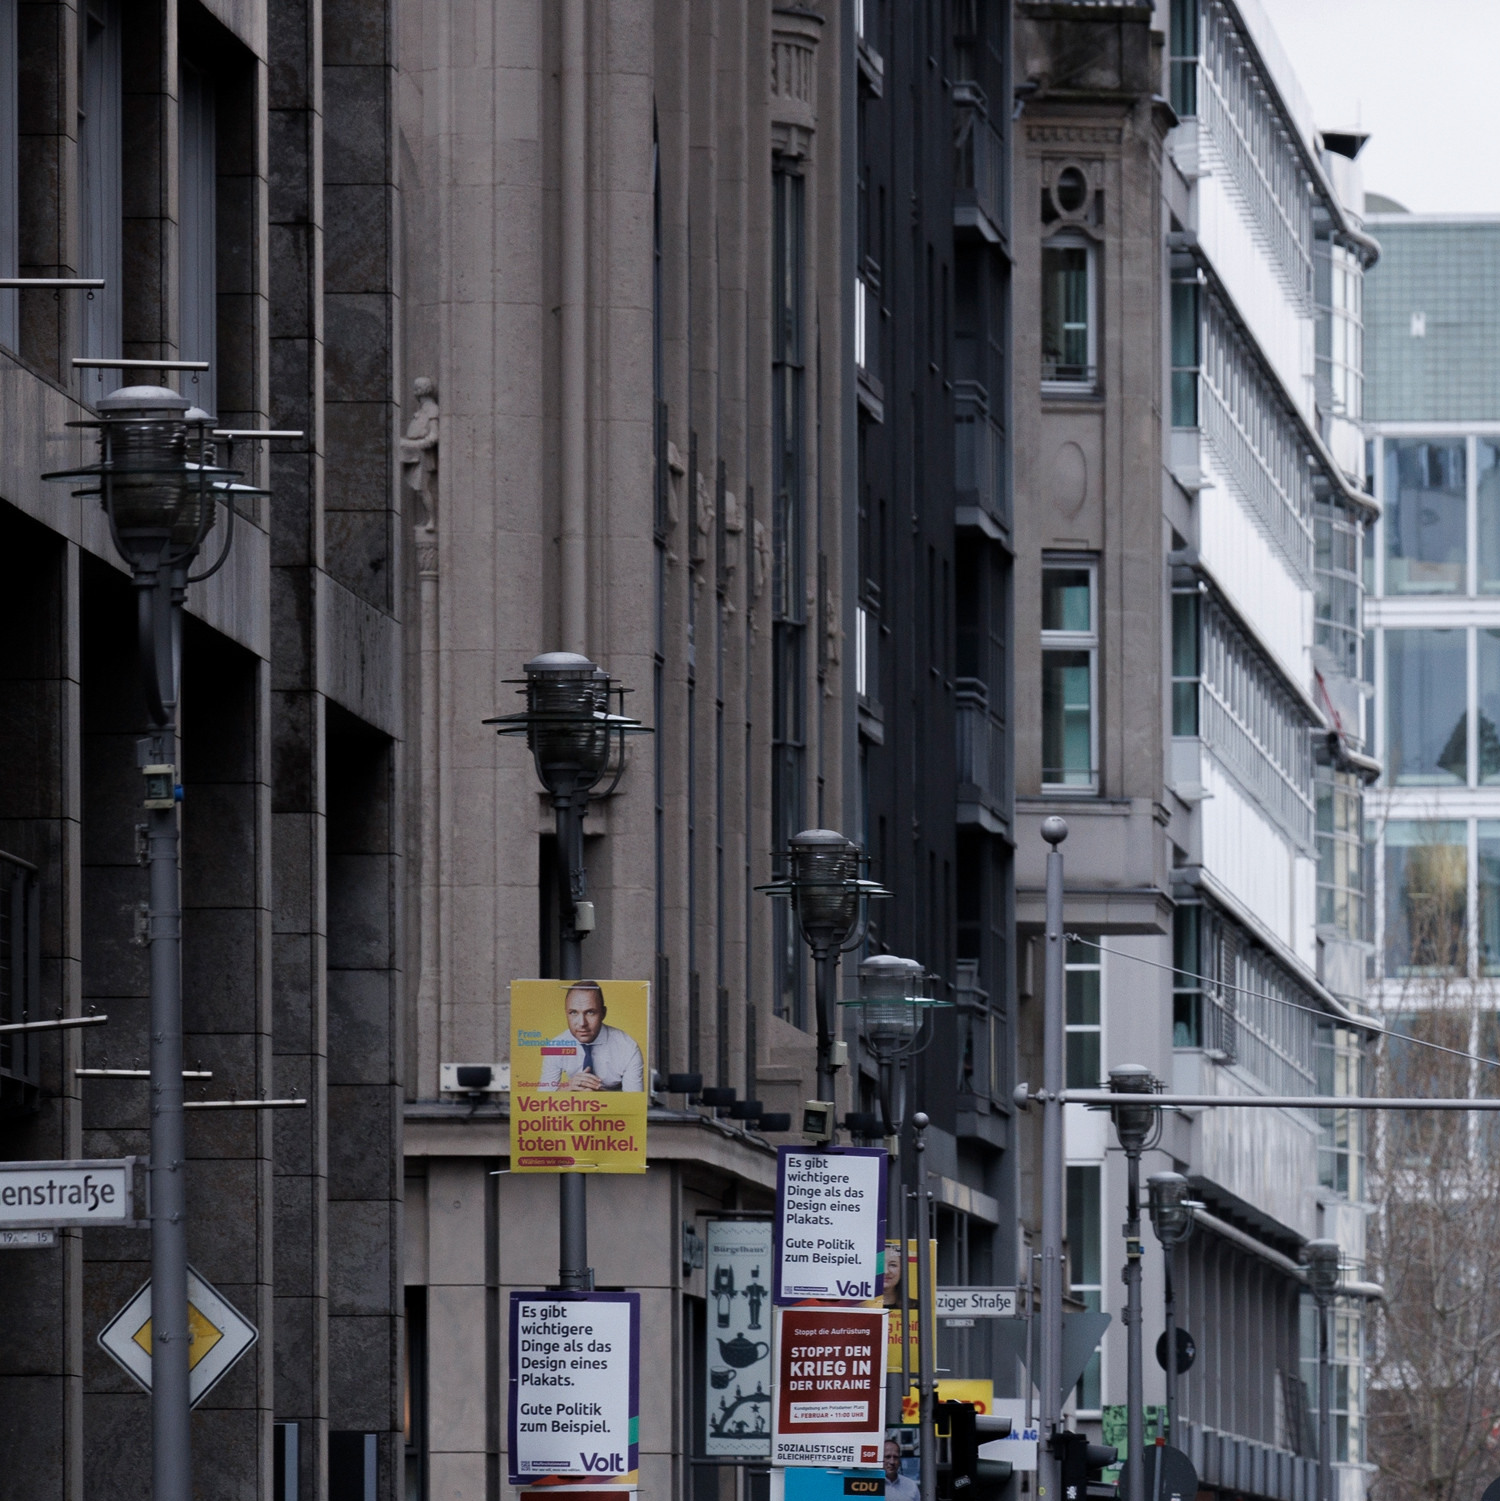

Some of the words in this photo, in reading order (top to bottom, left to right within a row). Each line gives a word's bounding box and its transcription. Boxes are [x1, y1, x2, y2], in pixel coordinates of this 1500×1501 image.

[518, 1030, 541, 1038] Freie
[517, 1038, 577, 1047] Demokraten
[517, 1096, 607, 1112] Verkehrs-
[518, 1116, 574, 1134] politik
[579, 1116, 626, 1131] ohne
[518, 1136, 566, 1151] toten
[571, 1136, 639, 1151] Winkel.
[2, 1175, 115, 1211] enstraße
[836, 1280, 871, 1297] Volt
[972, 1294, 1011, 1309] Straße
[522, 1306, 536, 1318] Es
[540, 1305, 567, 1320] gibt
[521, 1322, 593, 1337] wichtigere
[521, 1339, 560, 1354] Dinge
[563, 1339, 583, 1352] als
[588, 1339, 612, 1352] das
[521, 1356, 566, 1371] Design
[570, 1357, 608, 1369] eines
[521, 1374, 575, 1387] Plakats.
[521, 1403, 552, 1415] Gute
[557, 1402, 602, 1416] Politik
[520, 1423, 547, 1433] zum
[552, 1421, 611, 1435] Beispiel.
[1023, 1430, 1037, 1441] AG
[580, 1453, 624, 1473] Volt
[851, 1482, 878, 1492] CDU
